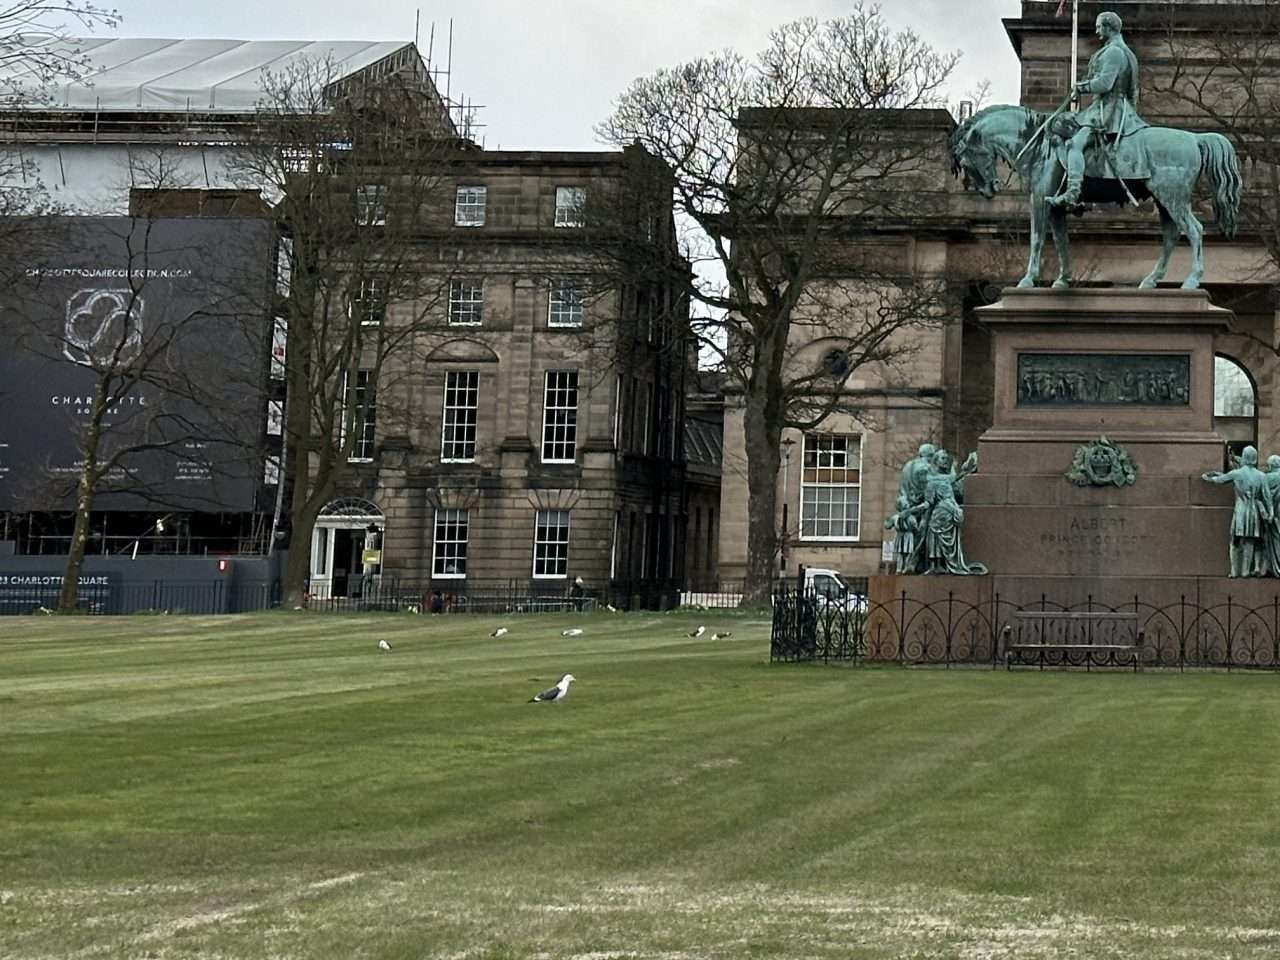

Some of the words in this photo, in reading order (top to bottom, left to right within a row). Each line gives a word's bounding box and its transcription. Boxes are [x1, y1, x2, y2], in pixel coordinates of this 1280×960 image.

[25, 268, 191, 278] CHOTTQUARECOLLECTION.COM
[52, 396, 145, 405] CHARTTE
[1070, 517, 1127, 529] ALBERT
[10, 576, 65, 585] CHARLOTT
[77, 576, 109, 585] QUARE
